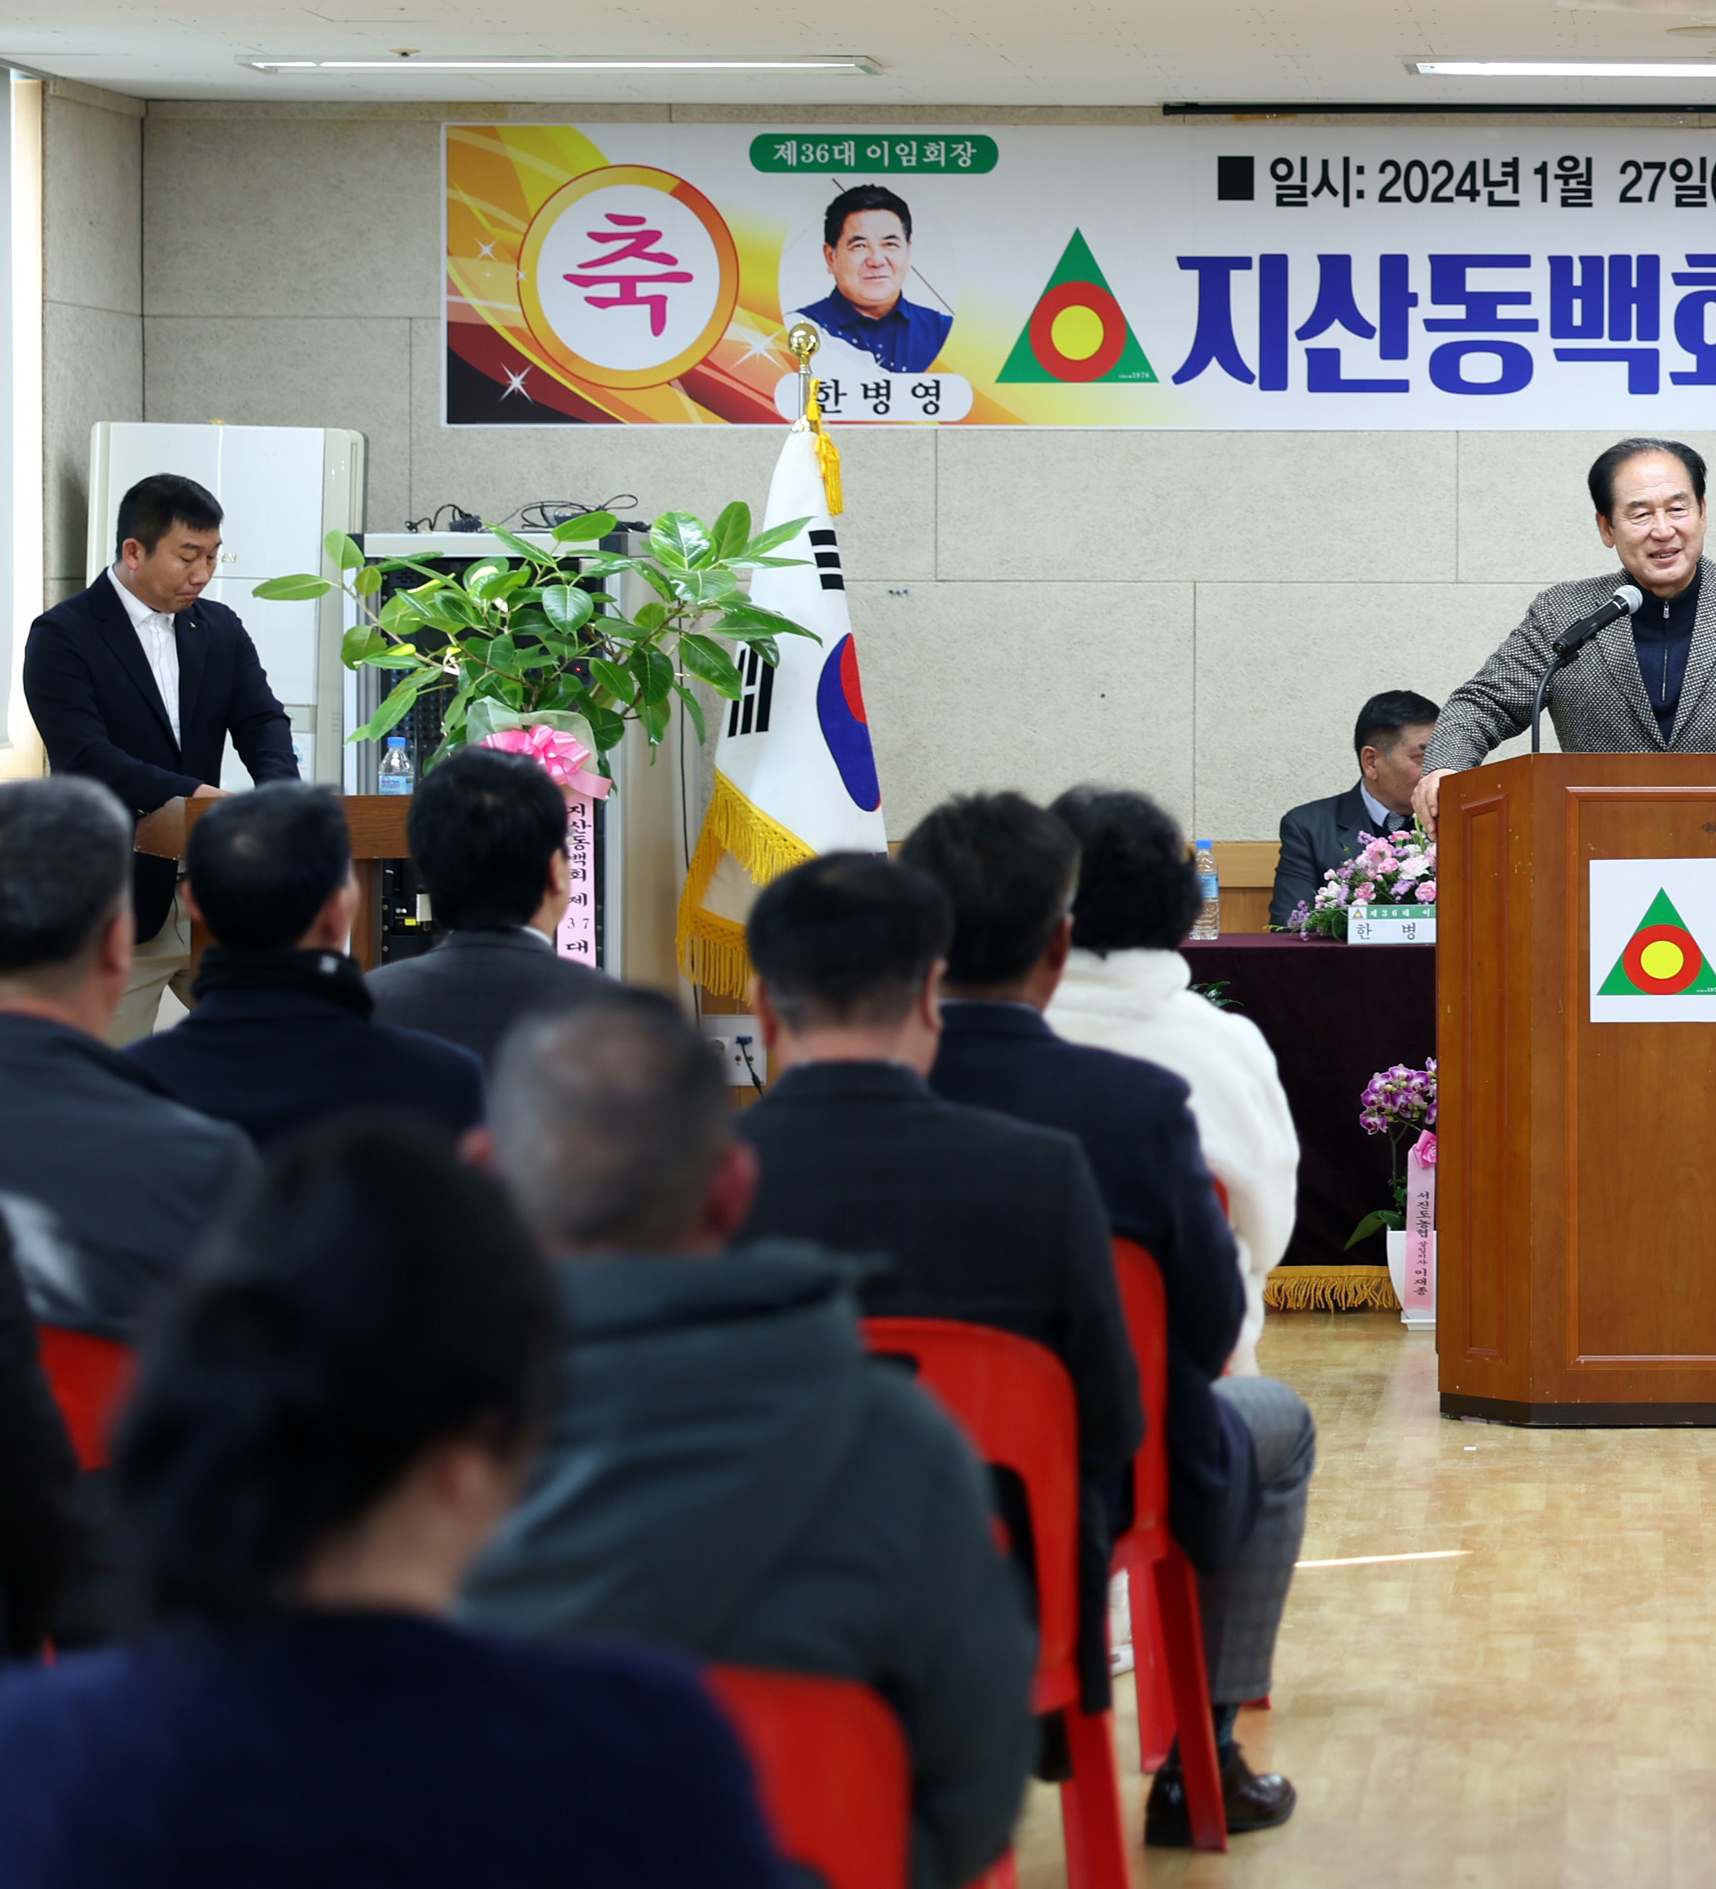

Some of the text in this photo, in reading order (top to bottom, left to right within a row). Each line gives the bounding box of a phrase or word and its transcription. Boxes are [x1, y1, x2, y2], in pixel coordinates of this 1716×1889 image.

[772, 138, 978, 168] 제36대 이임회장
[1268, 155, 1366, 209] 일시:
[1378, 155, 1521, 208] 2024년
[1532, 155, 1595, 209] 1월
[563, 212, 695, 338] 축
[567, 802, 592, 883] 지산동백회
